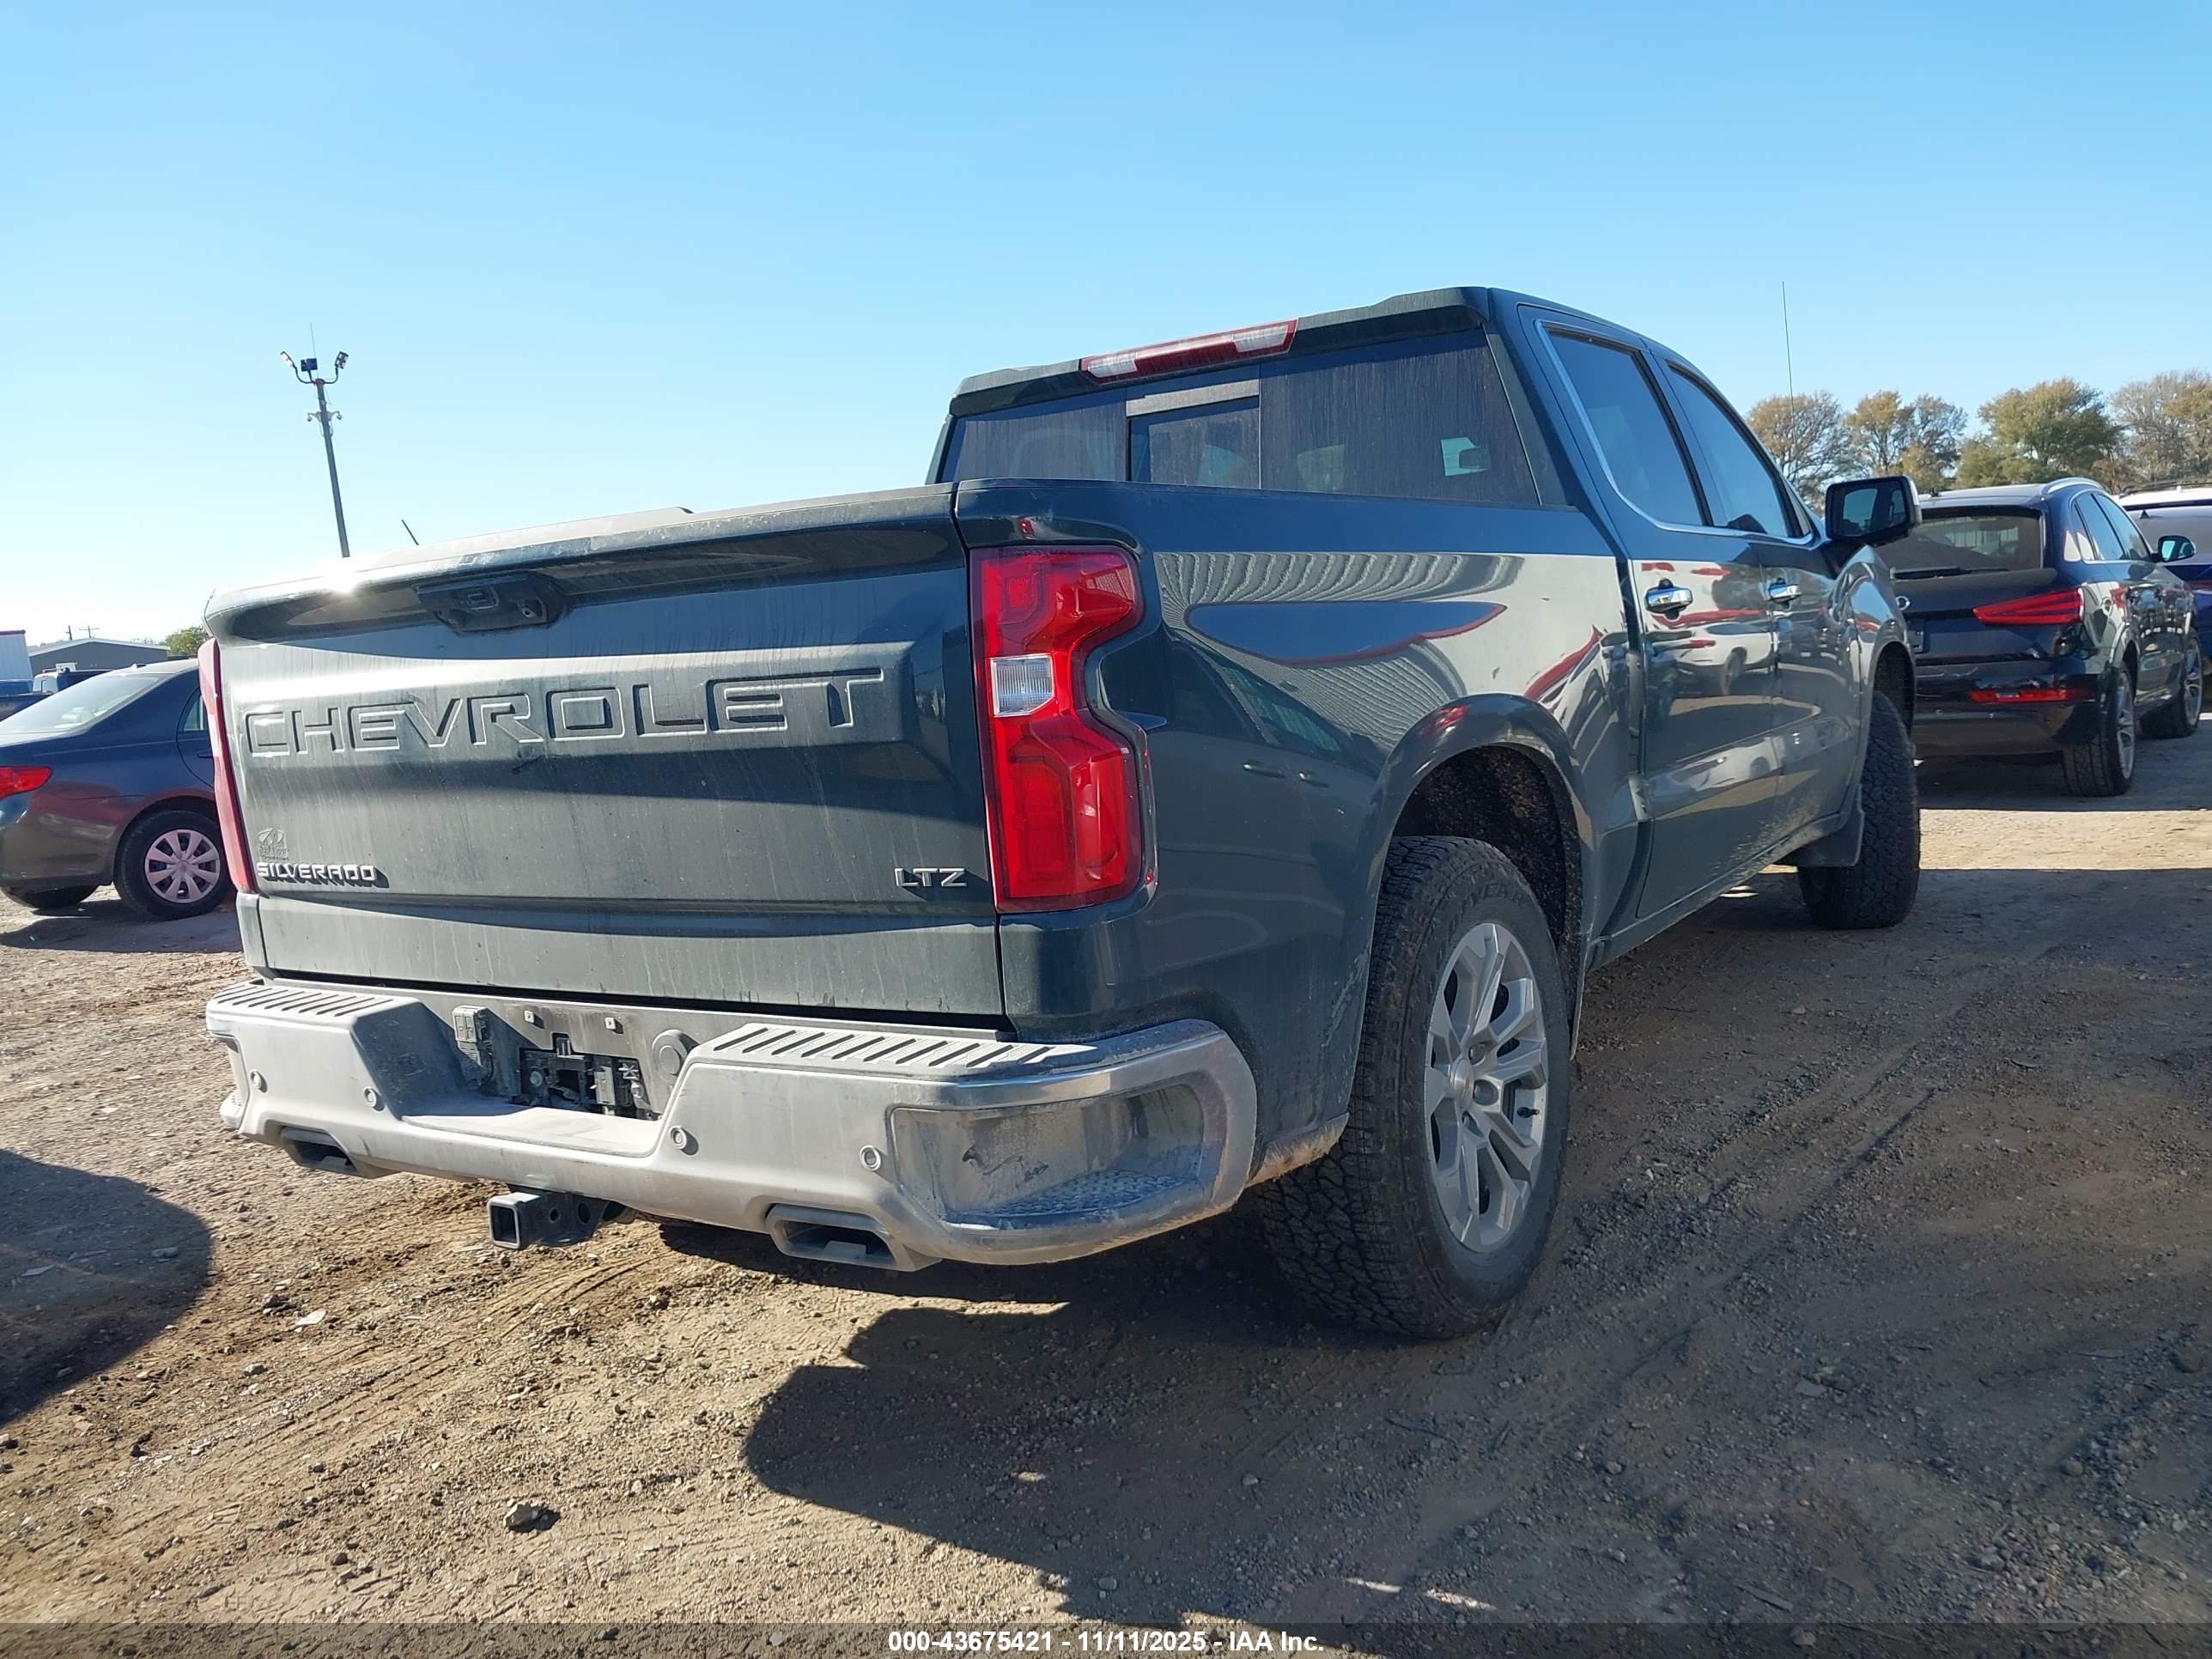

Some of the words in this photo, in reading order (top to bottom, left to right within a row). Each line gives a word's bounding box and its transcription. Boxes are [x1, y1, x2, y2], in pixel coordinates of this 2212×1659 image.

[245, 668, 885, 757] CHEVROLET
[257, 861, 376, 882] SILVERADO
[894, 867, 968, 887] LTZ
